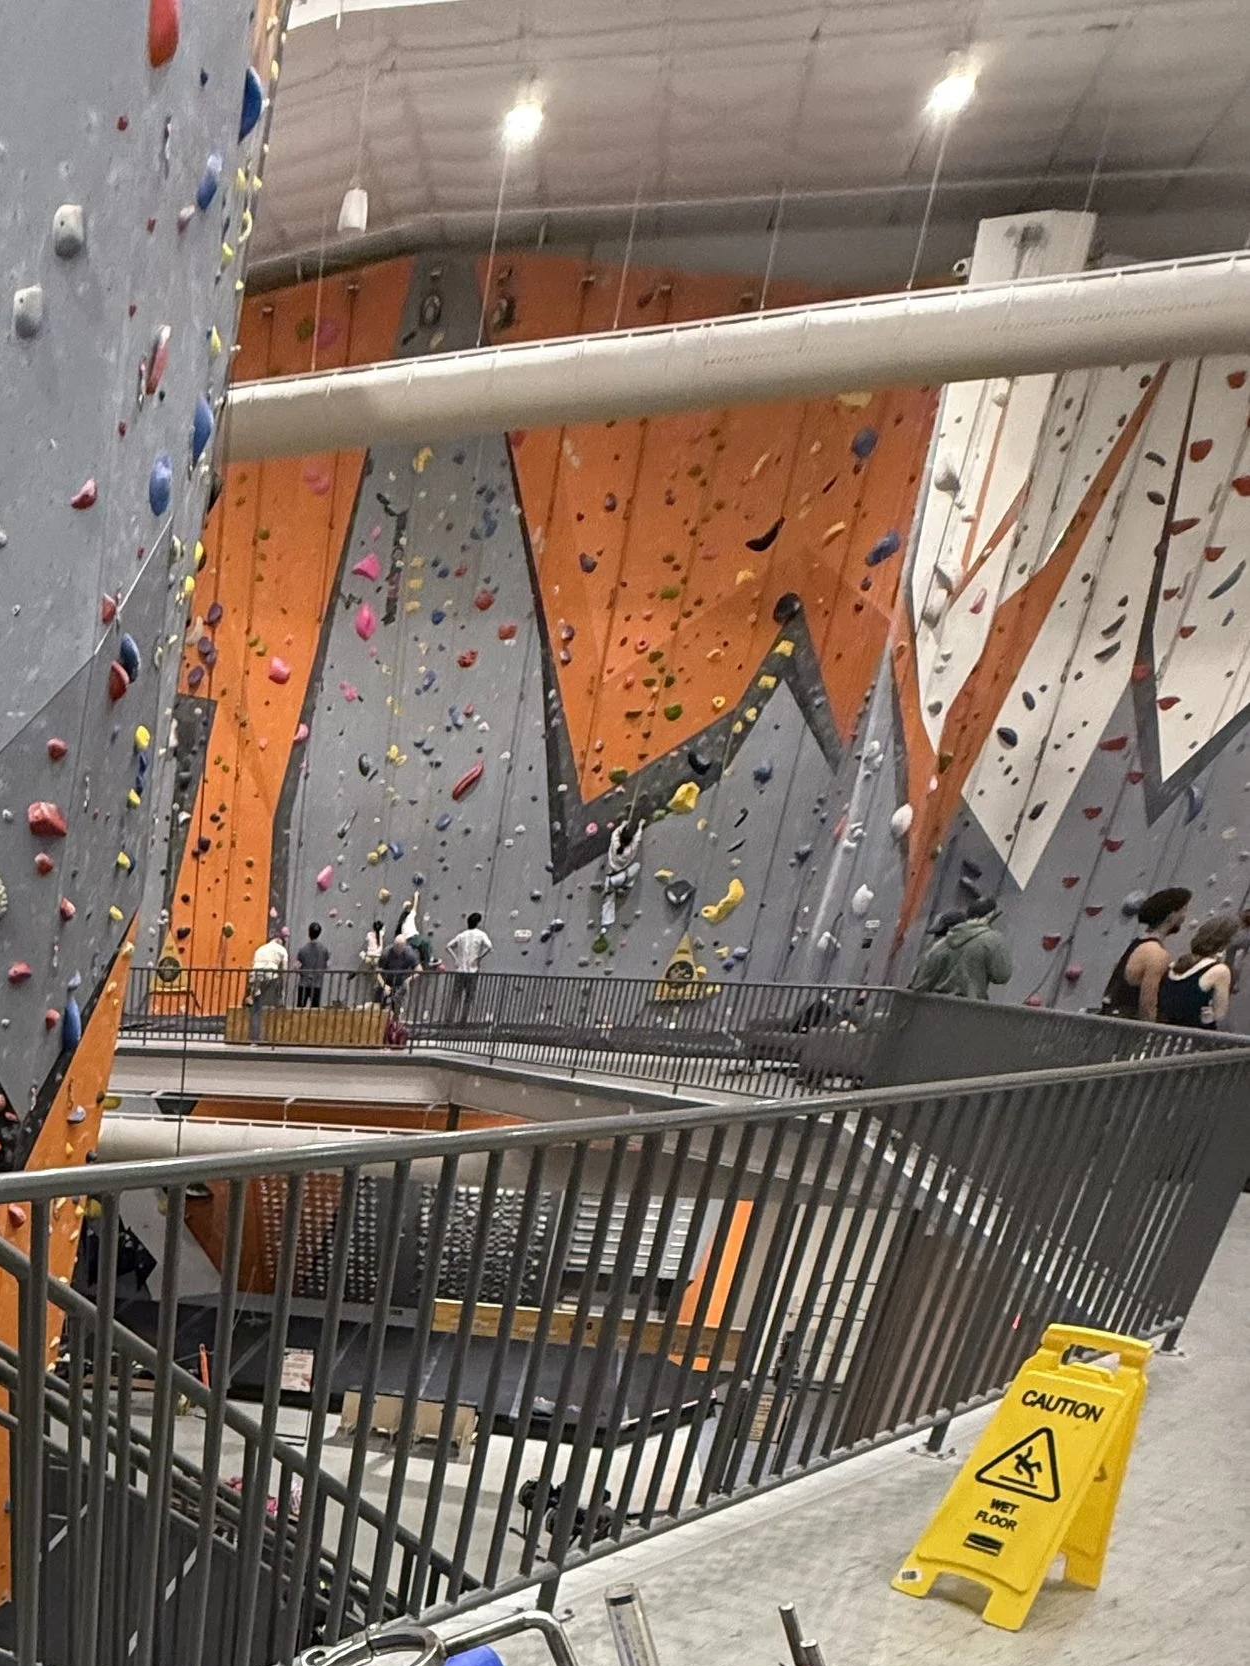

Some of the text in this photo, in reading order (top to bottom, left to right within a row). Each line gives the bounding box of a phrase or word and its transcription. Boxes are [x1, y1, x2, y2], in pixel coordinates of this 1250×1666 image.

[1022, 1389, 1105, 1423] CAUTION
[990, 1498, 1020, 1516] WET
[974, 1509, 1018, 1533] FLOOR
